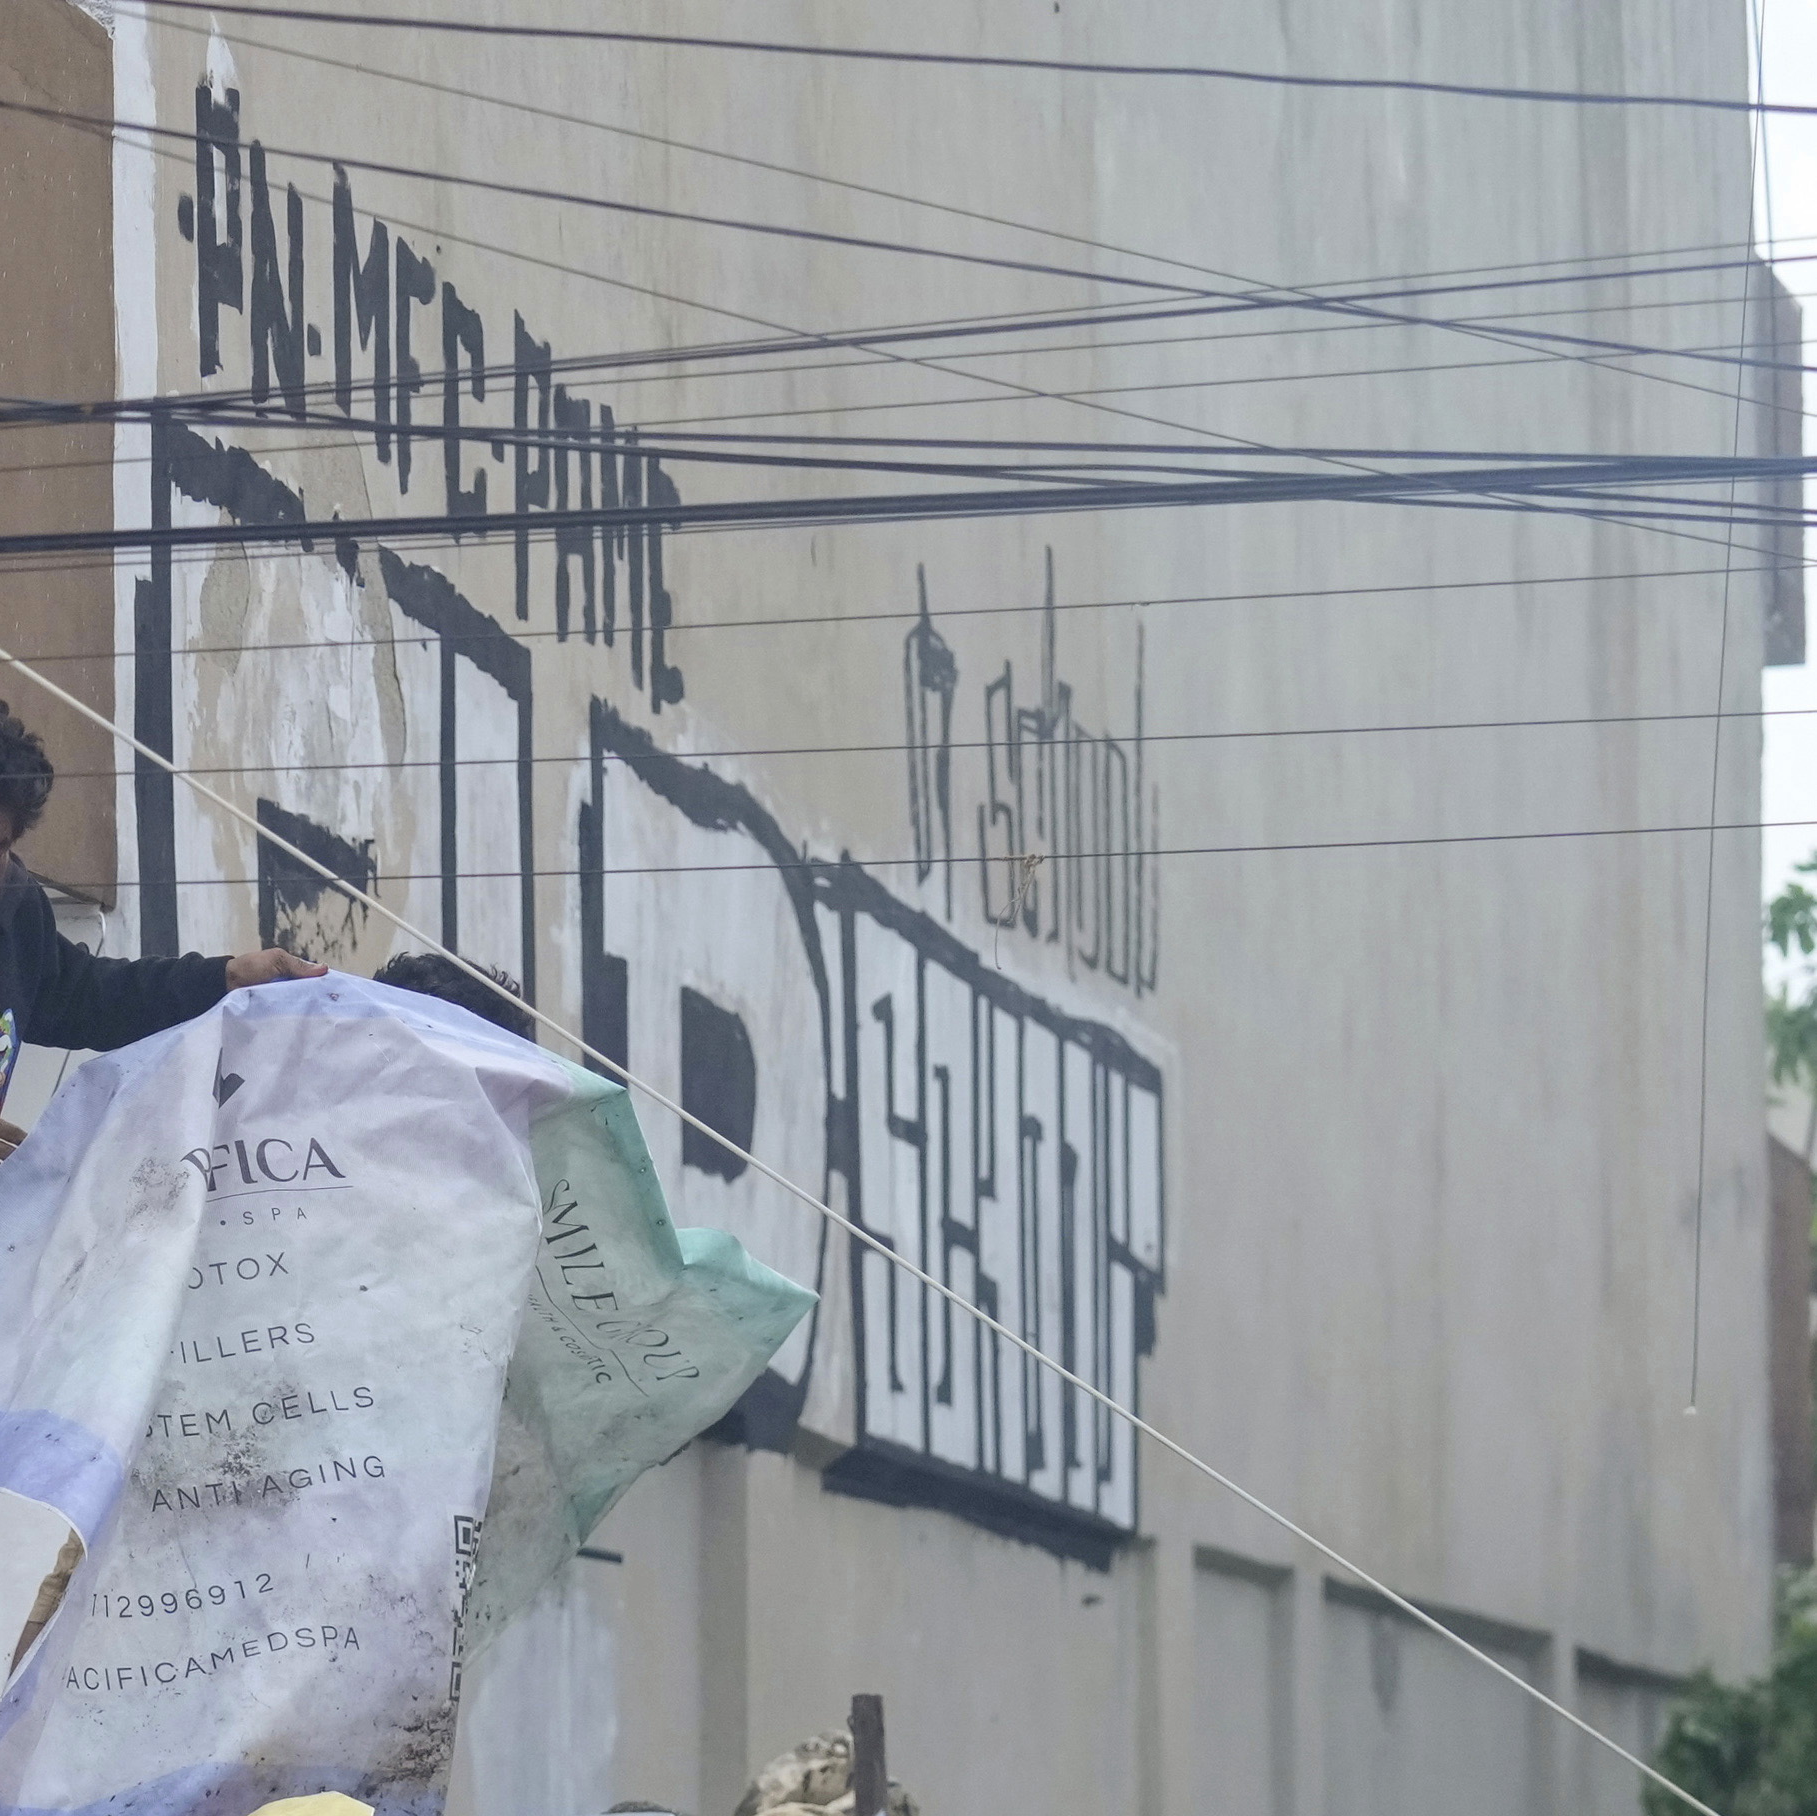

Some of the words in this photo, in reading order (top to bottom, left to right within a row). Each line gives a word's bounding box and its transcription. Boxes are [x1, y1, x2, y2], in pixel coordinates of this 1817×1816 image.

[188, 1252, 289, 1289] OTOX
[543, 1178, 619, 1311] SMILE
[172, 1323, 315, 1363] ILLERS
[147, 1409, 231, 1438] TEM
[252, 1387, 374, 1425] CELLS
[152, 1481, 242, 1512] ANTI
[262, 1455, 386, 1498] AGING
[66, 1625, 360, 1690] ACIFICAMEDSPA
